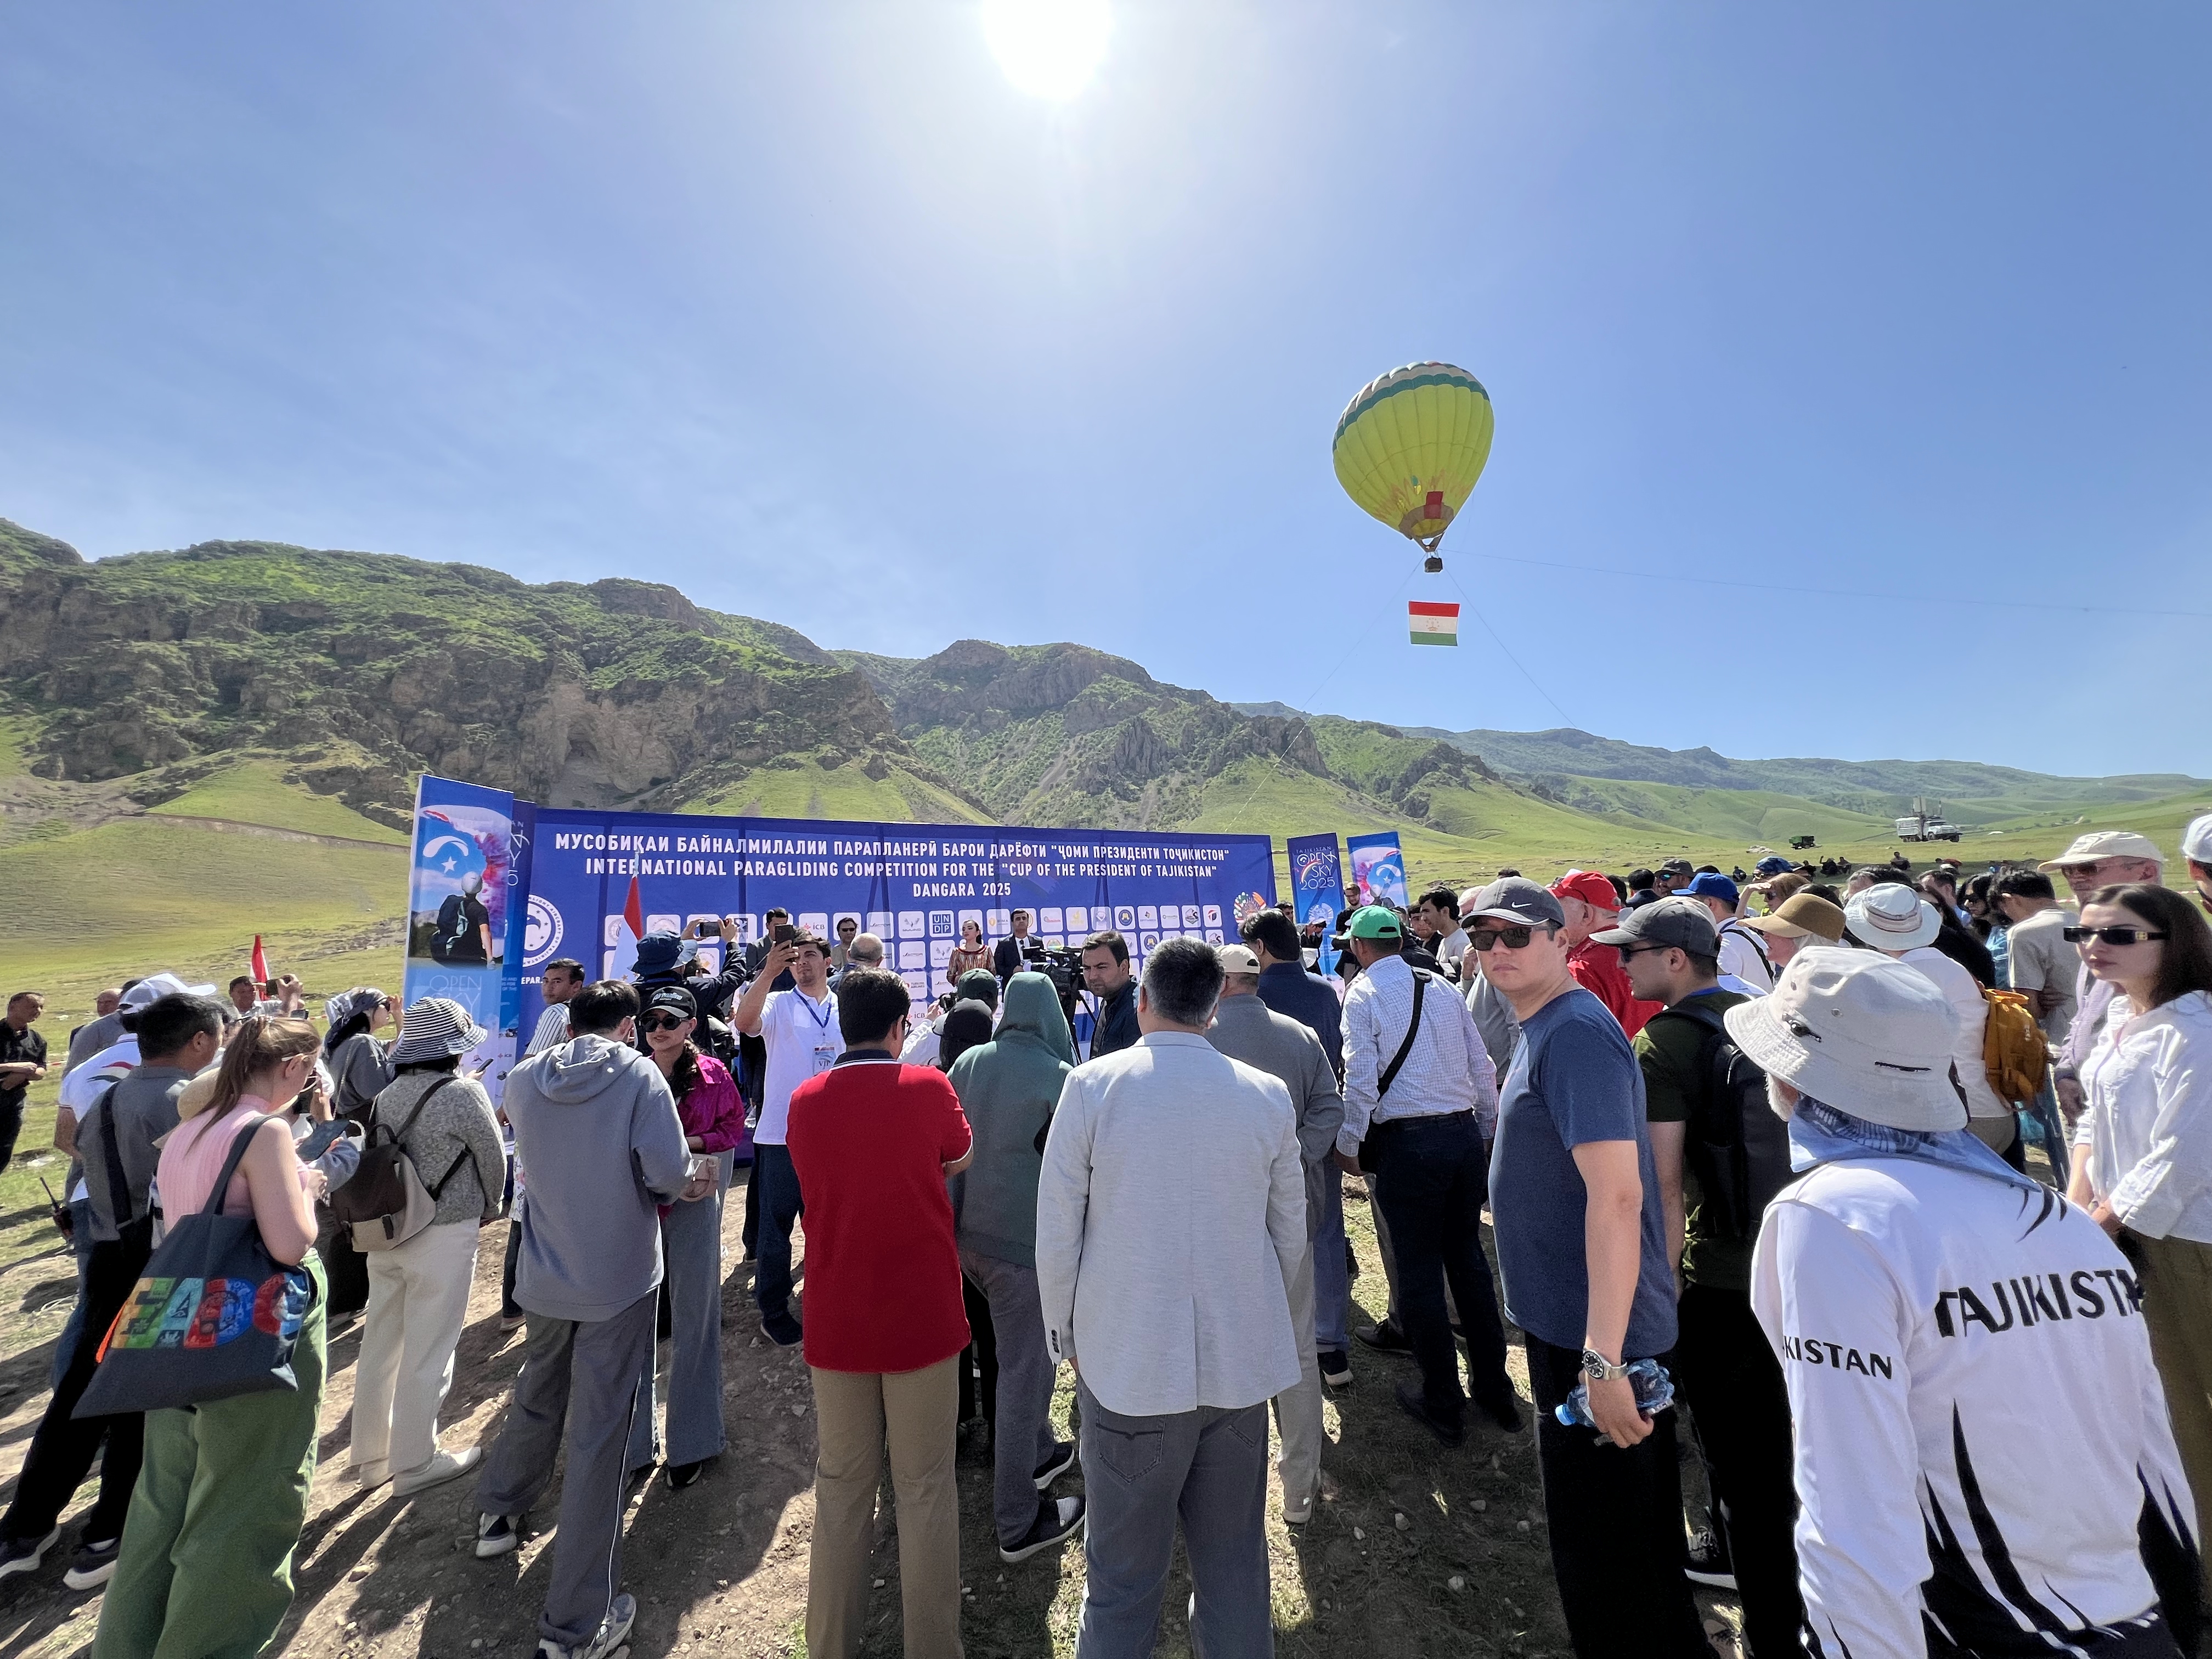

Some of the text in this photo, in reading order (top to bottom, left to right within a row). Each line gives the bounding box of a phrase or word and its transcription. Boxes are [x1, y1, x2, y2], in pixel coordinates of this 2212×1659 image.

[555, 833, 669, 854] МУСОБИҚАИ
[677, 834, 827, 855] БАЙНАЛМИЛАЛИИ
[834, 840, 936, 856] ПАРАПЛАНЕРӢ
[943, 843, 985, 857] БАРОИ
[990, 842, 1046, 859] ДАРЁФТИ
[1093, 846, 1160, 861] ПРЕЗИДЕНТИ
[1296, 845, 1331, 854] TAJIKISTAN
[1297, 851, 1337, 867] OPEN
[734, 860, 838, 877] PARAGLIDING
[844, 862, 937, 877] COMPETITION
[943, 863, 967, 877] FOR
[972, 863, 994, 876] THE
[1002, 863, 1032, 876] "CUP
[1037, 864, 1050, 876] OF
[1054, 864, 1075, 876] THE
[1080, 864, 1136, 877] PRESIDENT
[1141, 865, 1153, 877] OF
[1156, 865, 1217, 877] TAJIKISTAN"
[1311, 864, 1333, 878] SKY
[913, 882, 1011, 897] DANGARA 2025
[1300, 876, 1335, 890] 2025
[430, 975, 482, 992] OPEN
